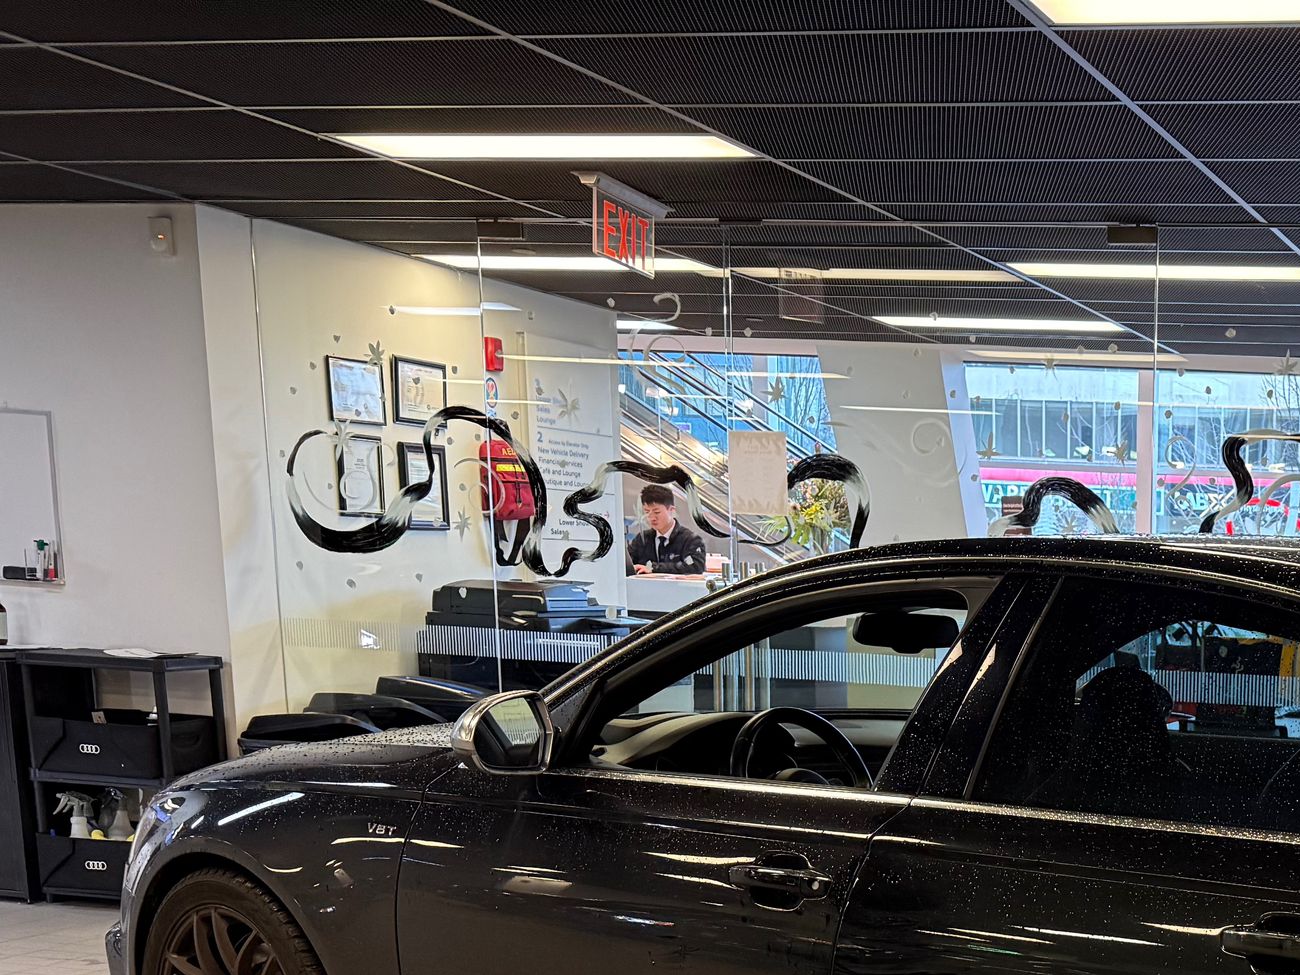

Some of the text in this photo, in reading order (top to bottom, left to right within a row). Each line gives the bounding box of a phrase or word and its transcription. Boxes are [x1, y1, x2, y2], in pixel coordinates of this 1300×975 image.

[603, 199, 649, 271] EXIT
[537, 431, 544, 443] 2
[537, 446, 590, 461] New Vehicle Delivery
[562, 469, 581, 480] Lounge
[563, 480, 574, 488] and
[558, 518, 575, 526] Lower
[368, 822, 397, 836] V8T
